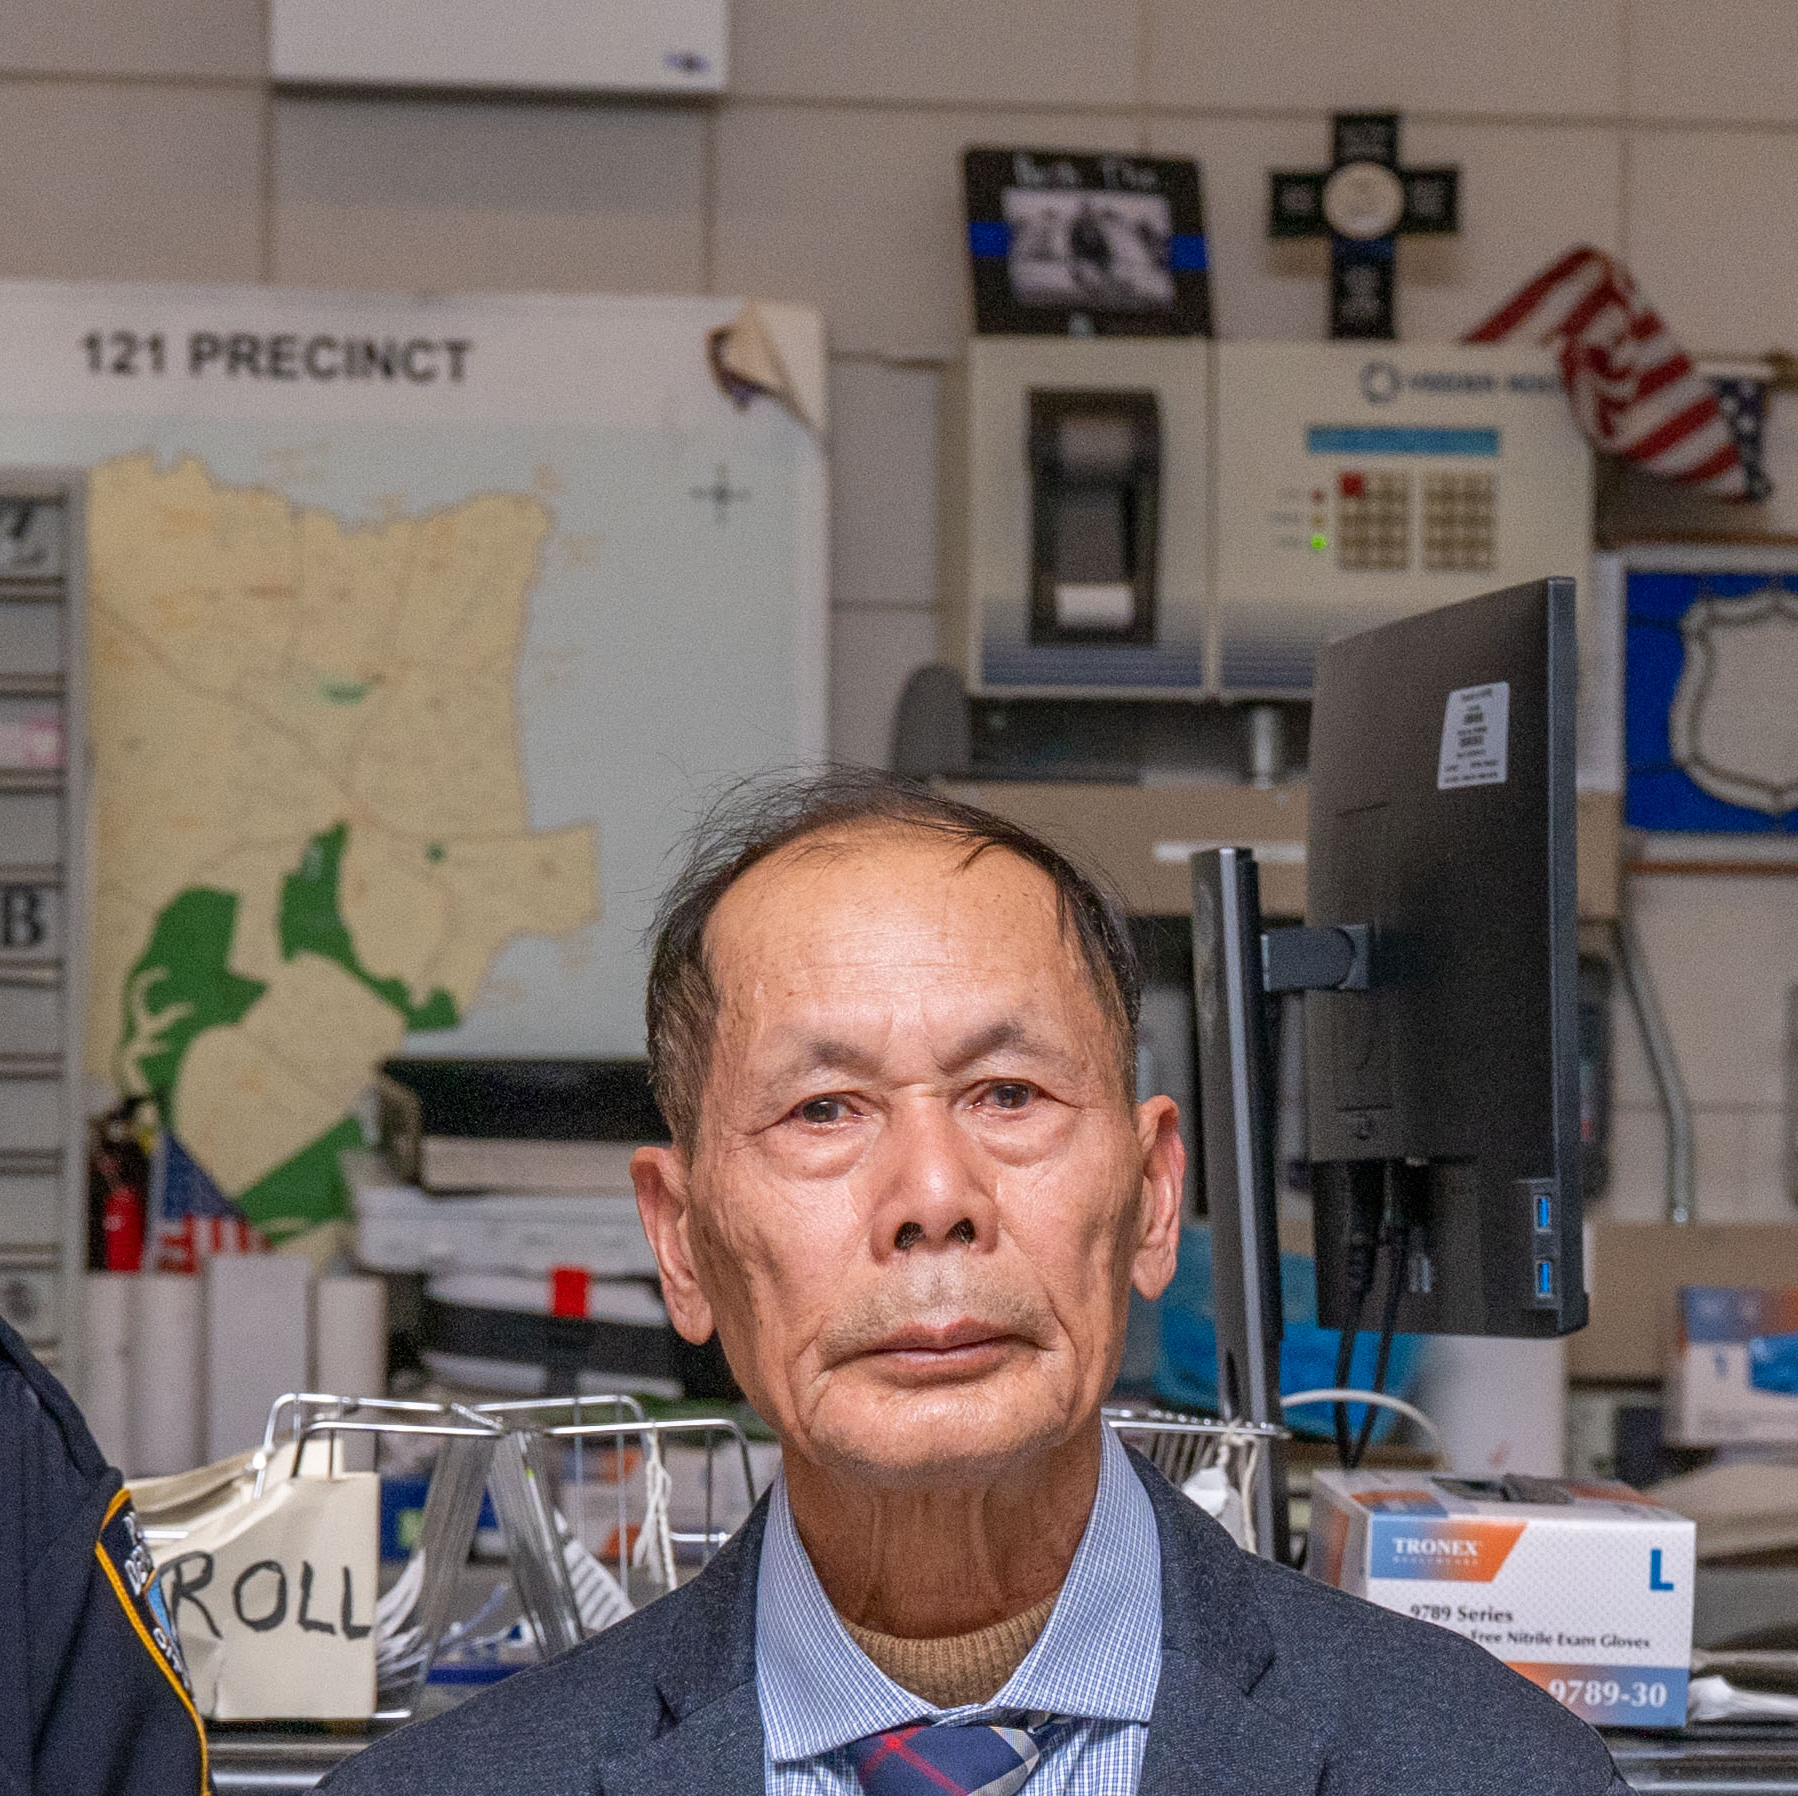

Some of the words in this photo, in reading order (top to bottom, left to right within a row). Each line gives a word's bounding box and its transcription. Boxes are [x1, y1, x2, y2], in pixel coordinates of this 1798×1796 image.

[81, 330, 167, 377] 121
[188, 331, 474, 384] PRECINCT
[3, 885, 46, 948] B
[1391, 1536, 1479, 1557] TRONEX
[1650, 1548, 1675, 1592] L
[157, 1550, 372, 1640] ROLL
[1410, 1603, 1452, 1621] 9789
[1457, 1604, 1514, 1623] Series
[1507, 1630, 1553, 1647] Nitrile
[1557, 1632, 1595, 1647] Exam
[1600, 1633, 1651, 1649] Gloves
[1548, 1678, 1669, 1708] 9789-30
